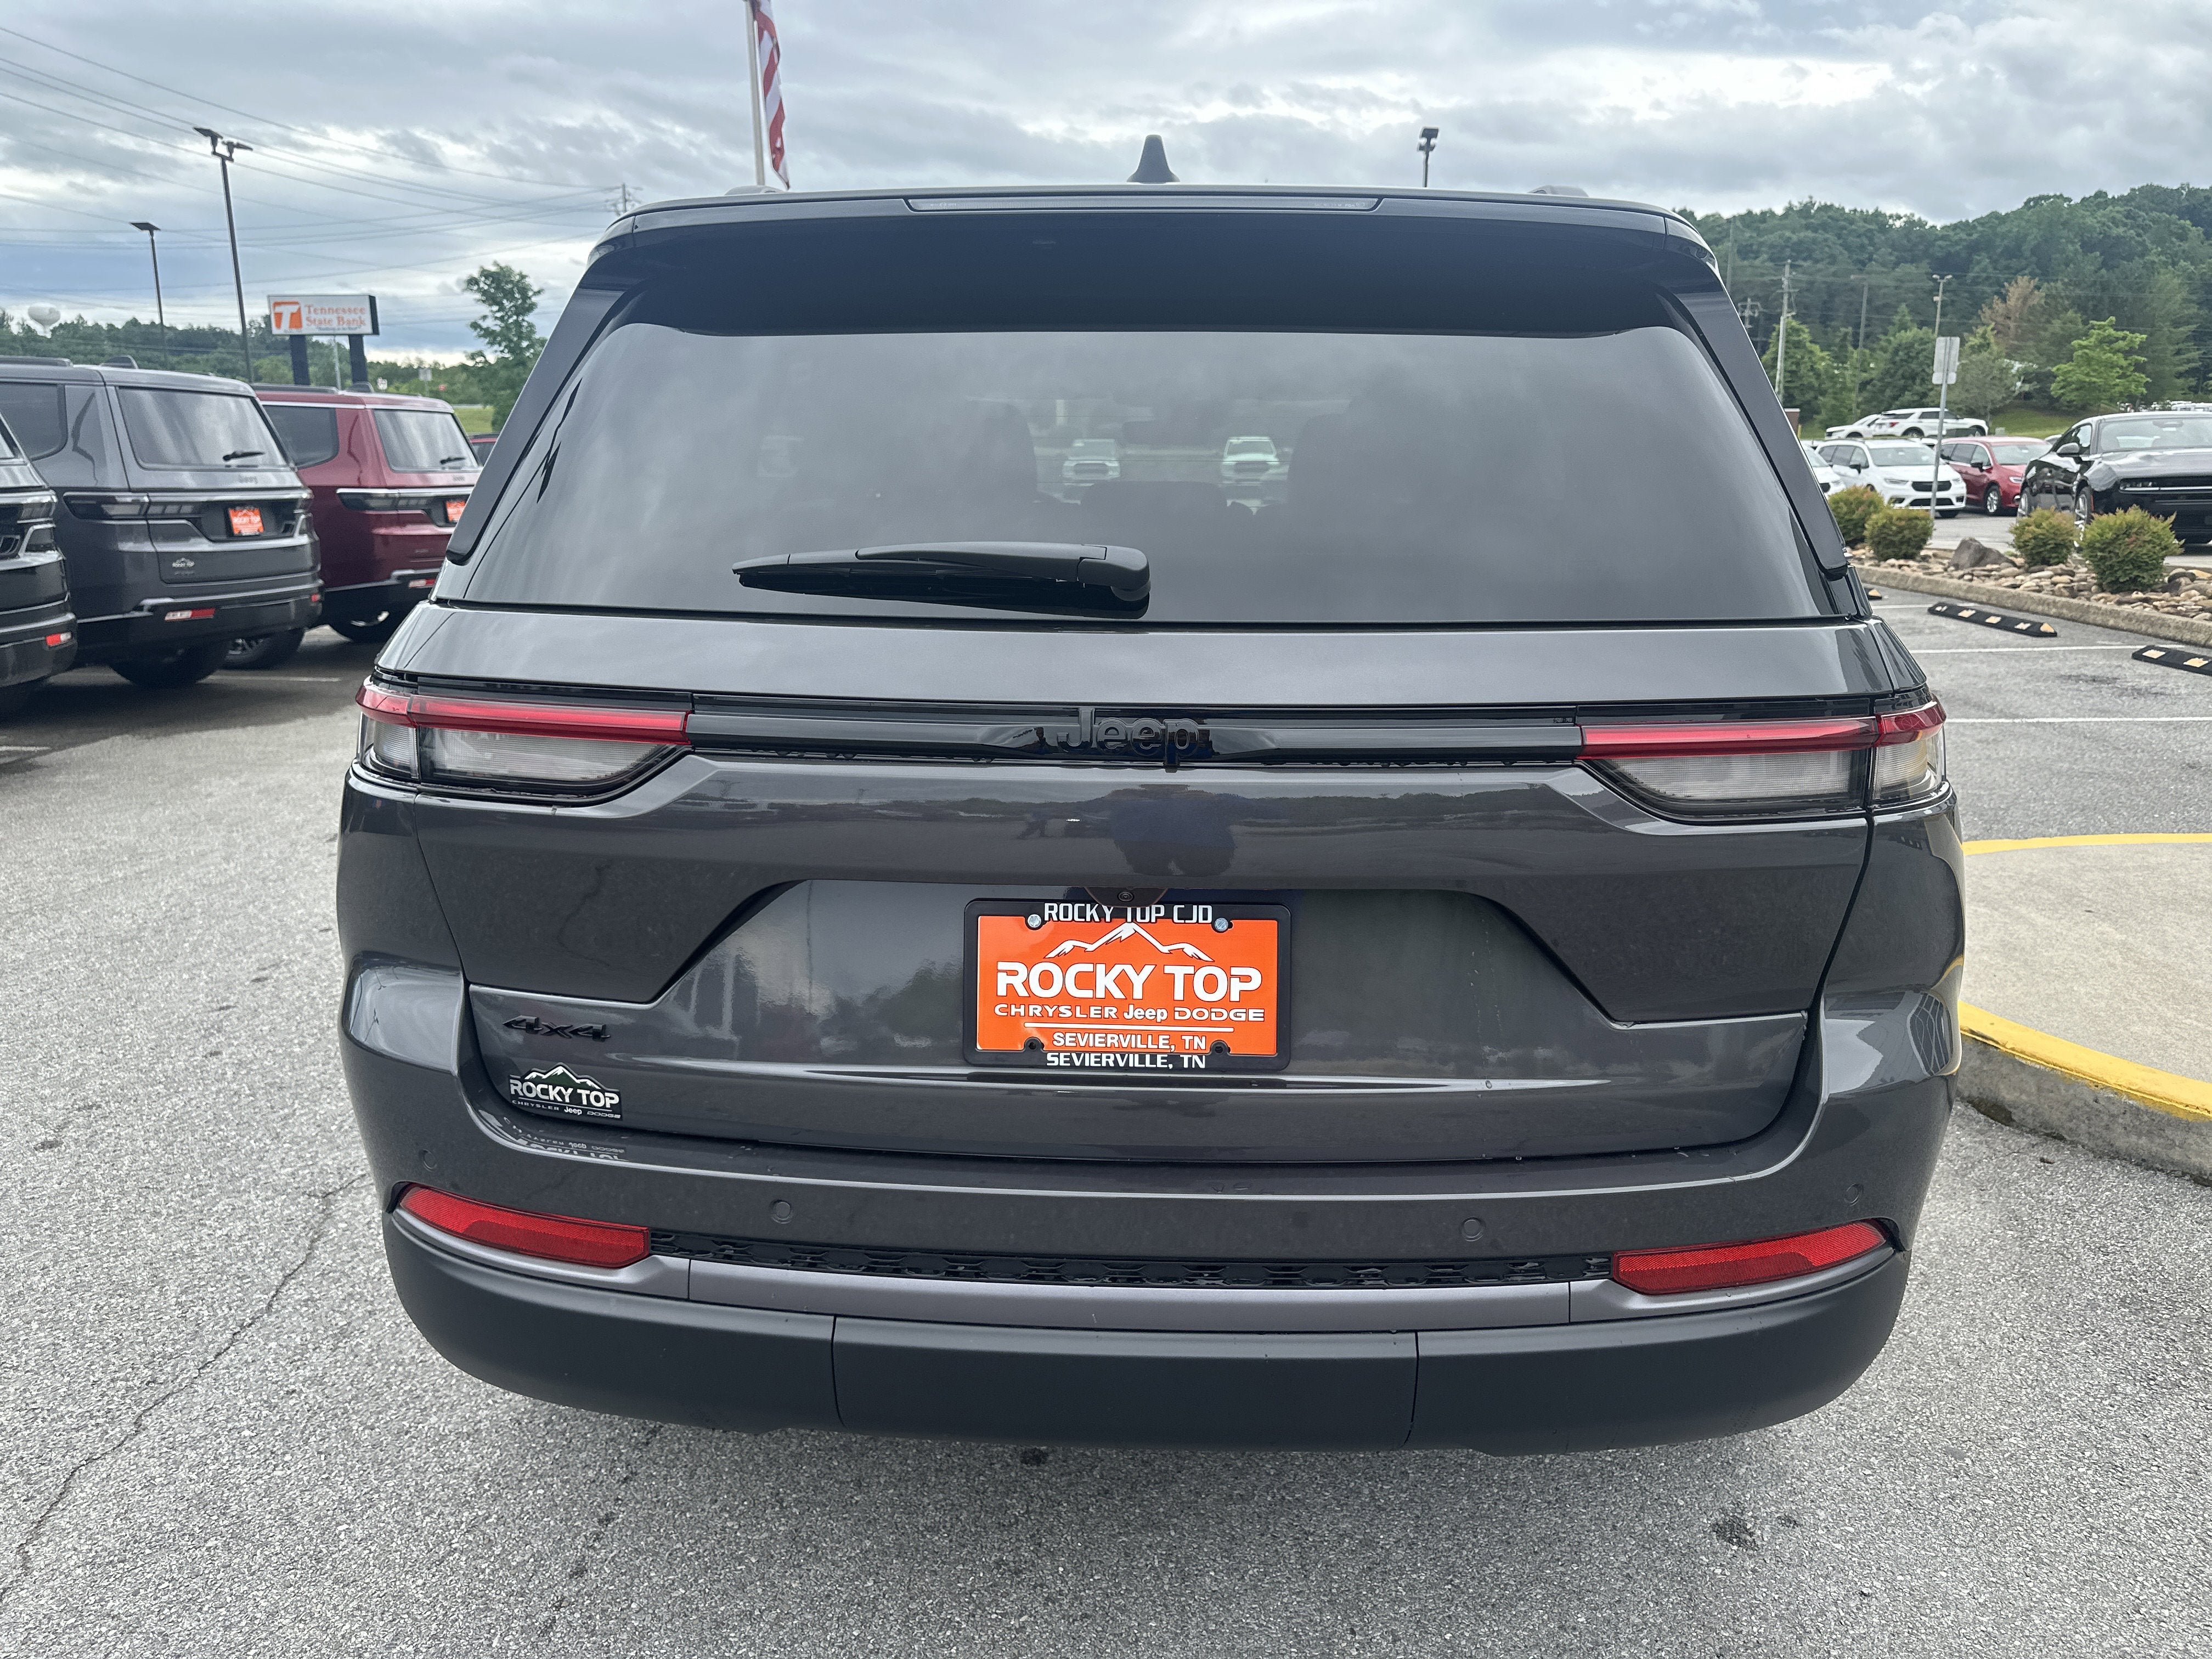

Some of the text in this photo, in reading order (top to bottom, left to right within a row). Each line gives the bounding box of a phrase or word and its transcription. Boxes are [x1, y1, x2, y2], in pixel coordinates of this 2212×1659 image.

[304, 304, 365, 314] Tennessee
[306, 315, 366, 326] State Bank
[1057, 707, 1199, 769] Jeep
[1044, 902, 1114, 922] ROCKY
[1173, 905, 1212, 923] CJD
[996, 961, 1262, 1002] ROCKY TOP
[994, 1003, 1265, 1023] CHRYSLER Jeep DODGE
[503, 1015, 611, 1042] 4x4
[1052, 1032, 1206, 1052] SEVIERVILLE, TN
[1046, 1052, 1205, 1069] SEVIERVILLE, TN
[510, 1079, 619, 1108] ROCKY TOP
[512, 1100, 560, 1110] CHRYSLER
[564, 1106, 583, 1115] Jeep
